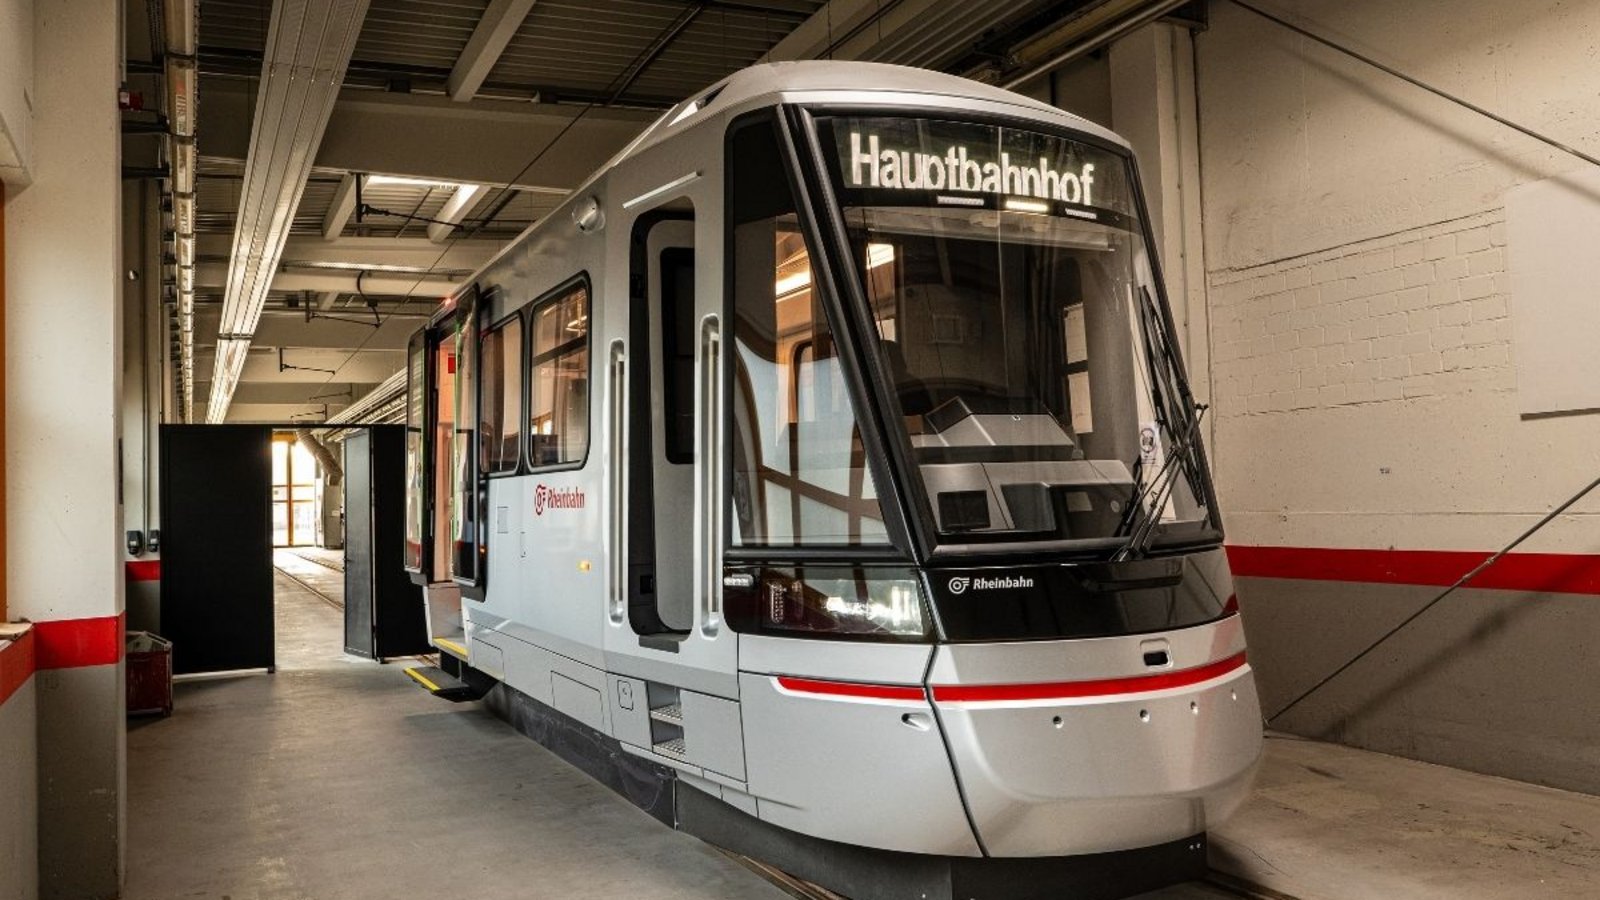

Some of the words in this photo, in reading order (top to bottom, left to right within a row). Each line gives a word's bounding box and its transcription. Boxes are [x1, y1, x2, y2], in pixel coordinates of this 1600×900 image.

[850, 132, 1095, 206] Hauptbahnhof
[547, 486, 585, 509] Rheinbahn
[972, 575, 1034, 590] Rheinbahn
